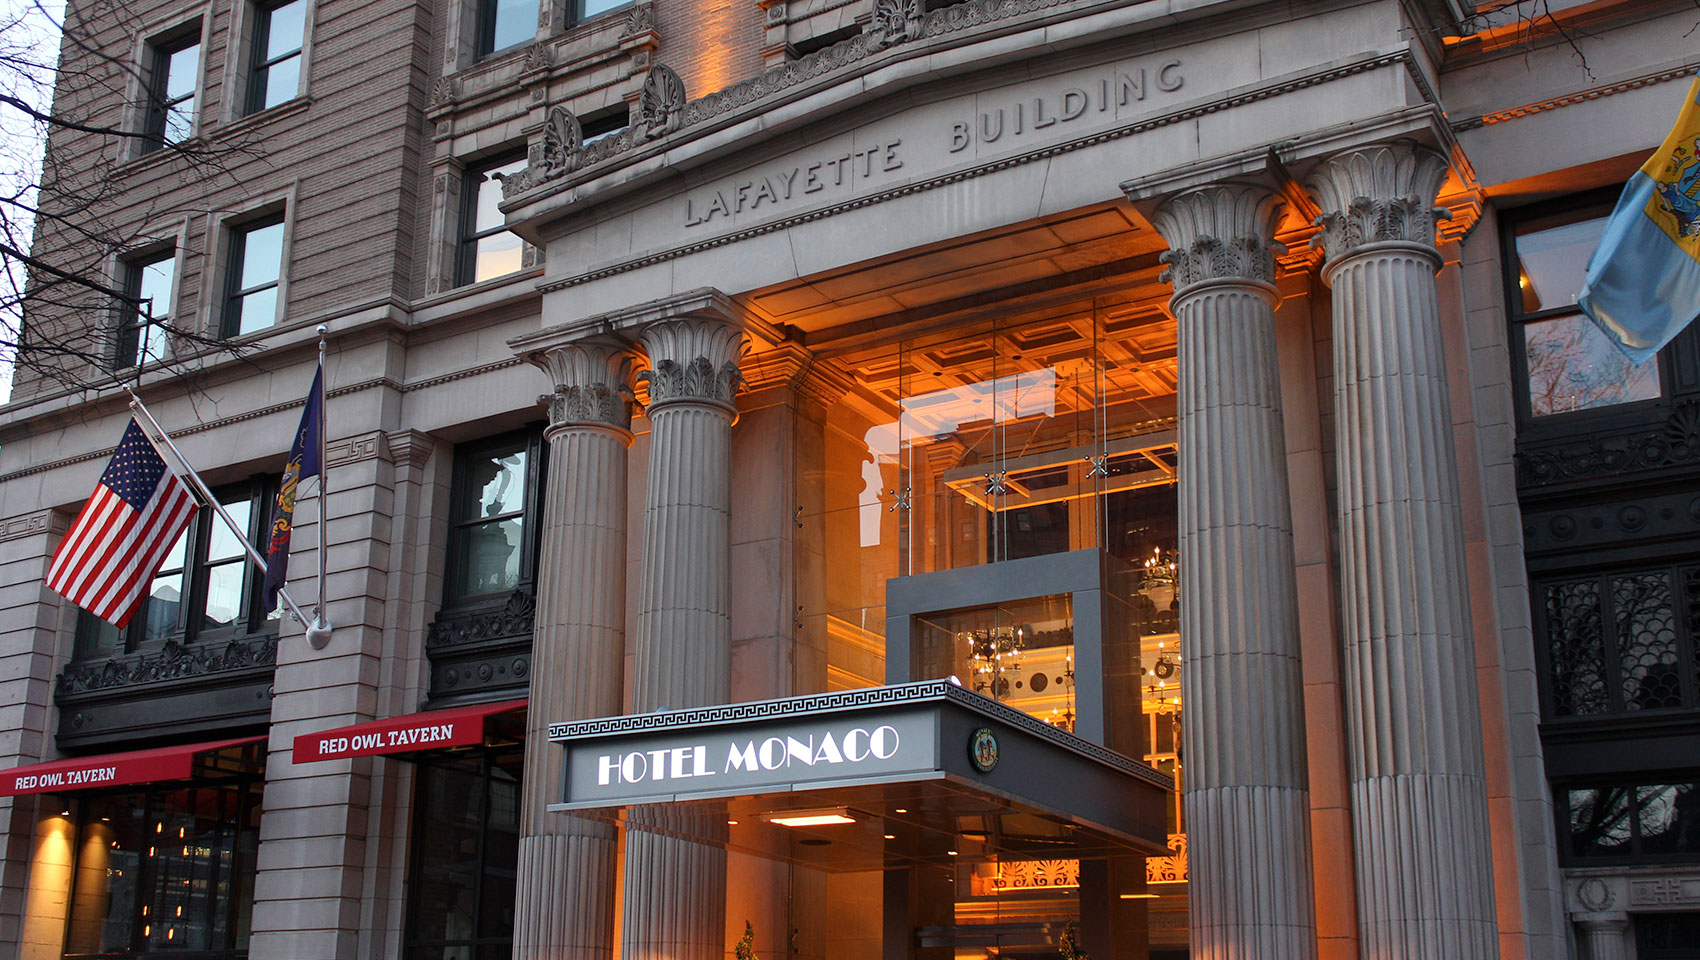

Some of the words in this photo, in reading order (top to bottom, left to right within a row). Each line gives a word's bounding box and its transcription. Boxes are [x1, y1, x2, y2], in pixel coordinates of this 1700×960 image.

[683, 137, 902, 227] LAFAYETTE
[948, 59, 1185, 154] BUILDING
[318, 737, 349, 755] RED
[351, 732, 386, 751] OWL
[388, 724, 454, 746] TAVERN
[597, 745, 716, 786] HOTEL
[724, 724, 900, 774] MONACO
[15, 775, 38, 790] RED
[39, 773, 65, 788] OWL
[67, 767, 116, 785] TAVERN
